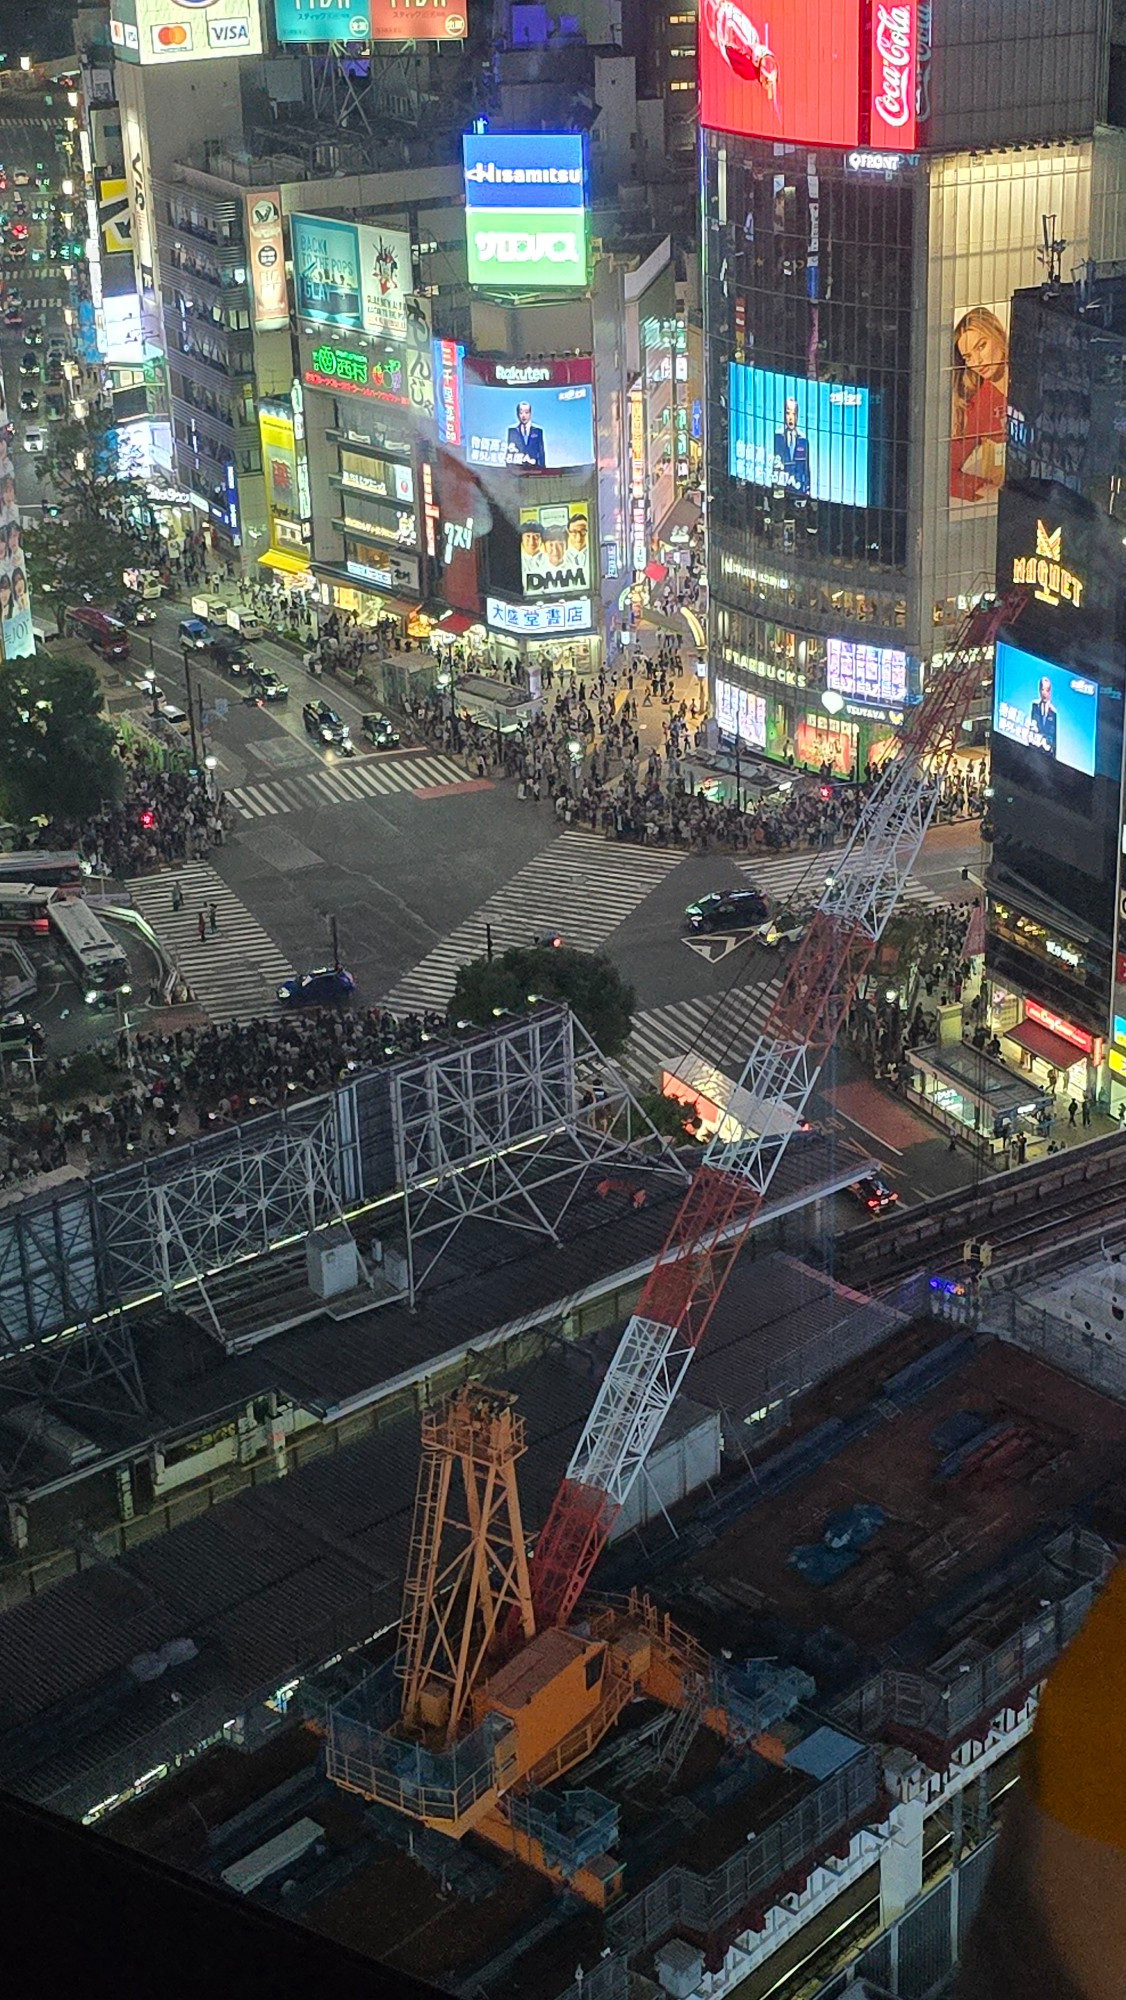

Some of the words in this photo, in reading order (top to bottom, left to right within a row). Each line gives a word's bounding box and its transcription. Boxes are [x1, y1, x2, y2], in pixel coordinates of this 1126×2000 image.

[211, 25, 249, 41] VISA
[874, 3, 911, 127] Coca-Cola
[466, 162, 582, 184] Hisamitsu
[495, 365, 550, 381] Rakuten
[526, 567, 587, 592] DMM
[492, 604, 584, 627] 大盛堂書店
[725, 648, 807, 688] STARBUCKS
[846, 704, 886, 721] TSUTAYA
